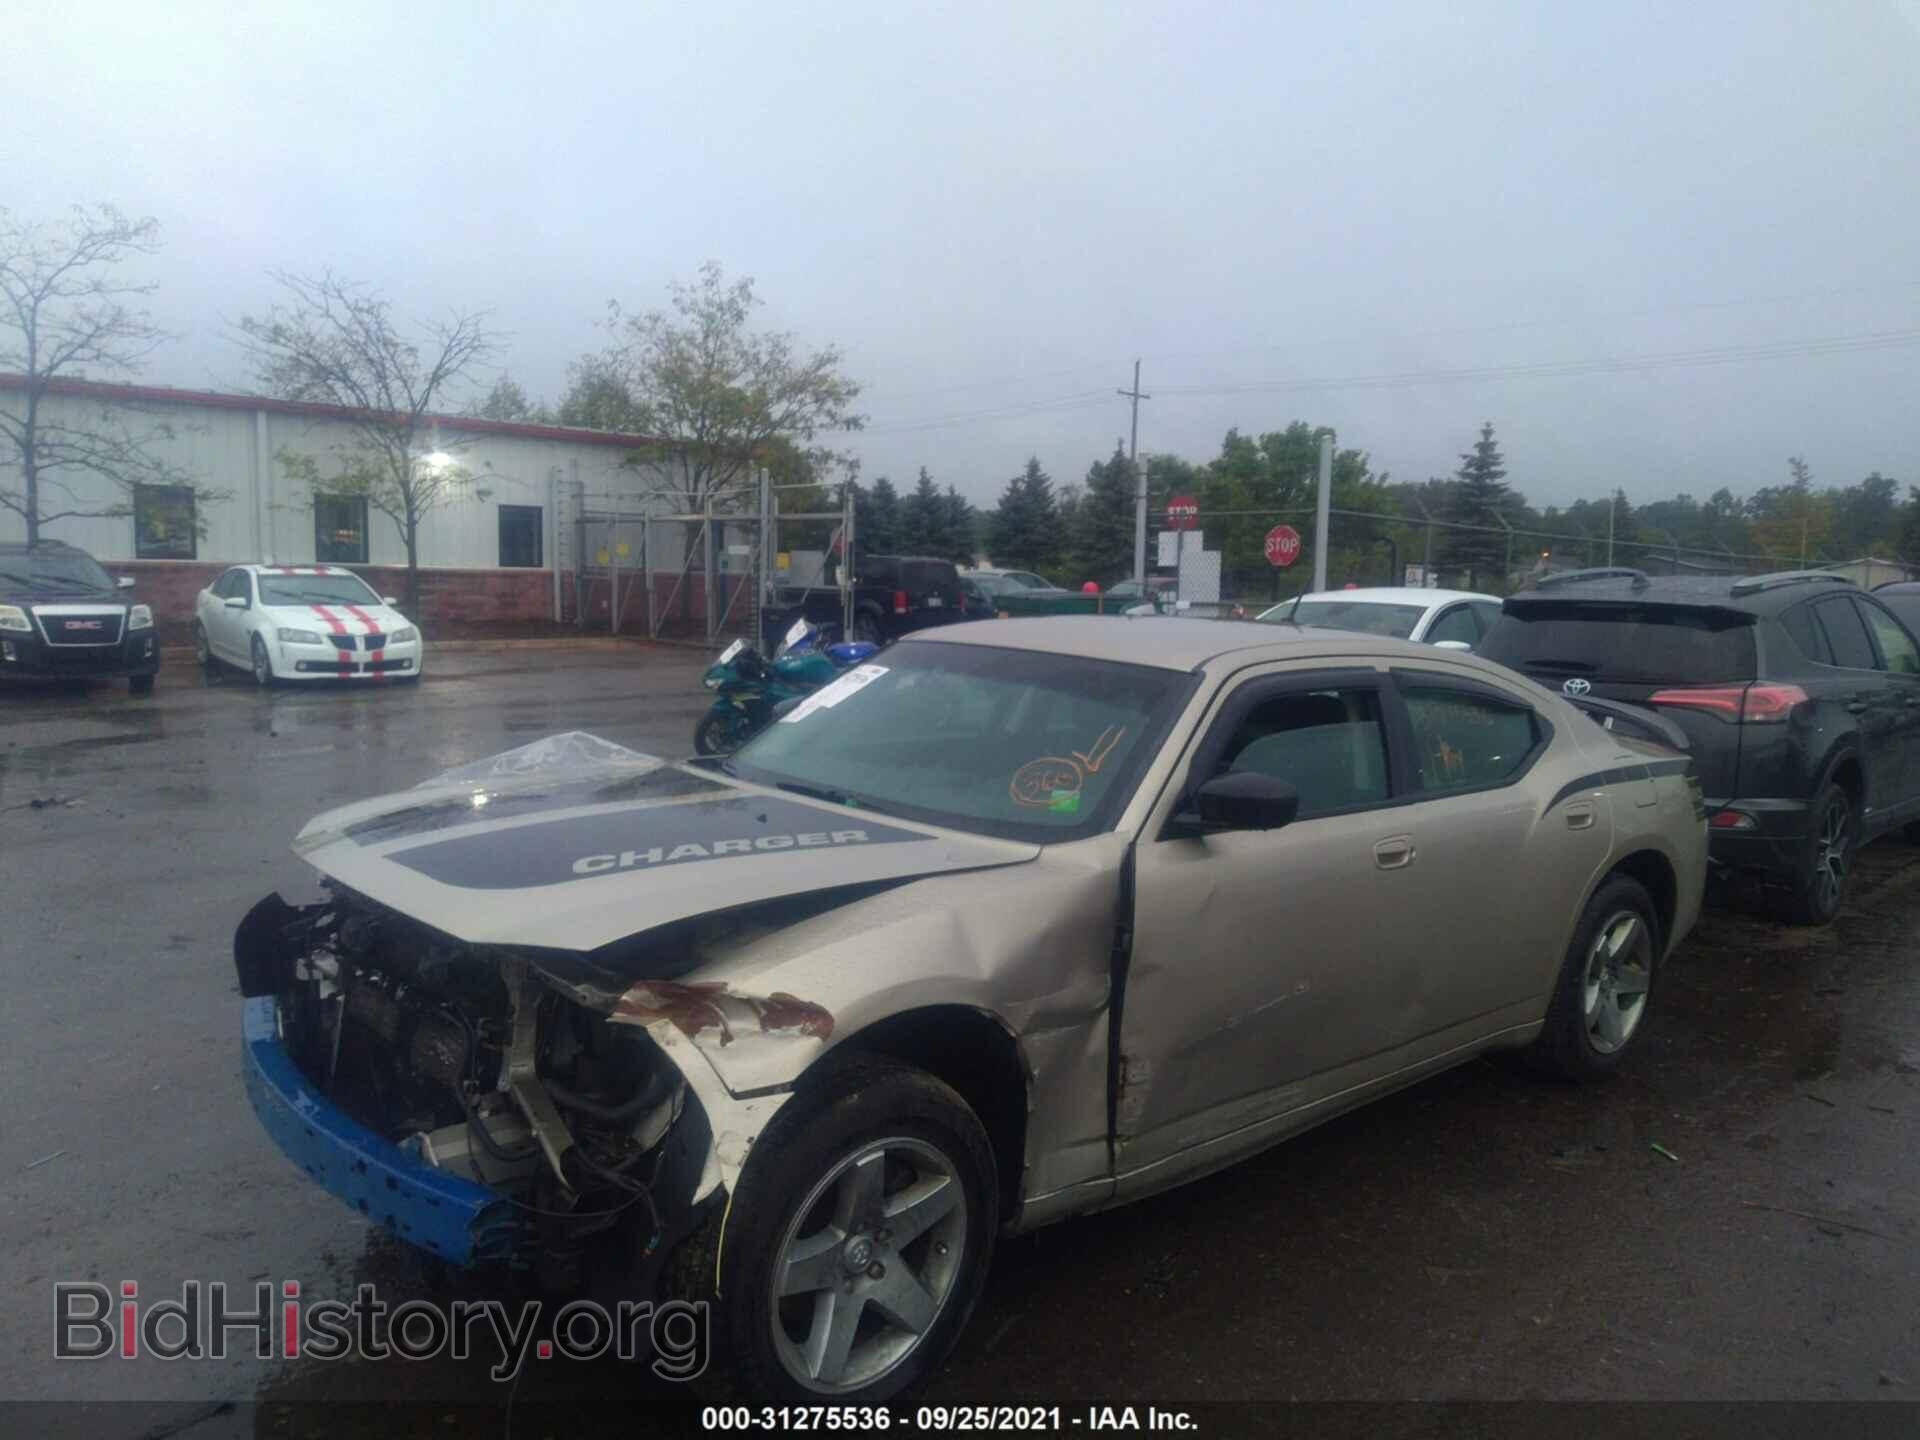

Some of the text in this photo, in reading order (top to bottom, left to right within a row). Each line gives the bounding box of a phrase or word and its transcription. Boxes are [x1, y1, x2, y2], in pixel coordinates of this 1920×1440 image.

[1266, 536, 1299, 554] STOP
[65, 620, 103, 631] GMC
[572, 829, 869, 874] CHARGER
